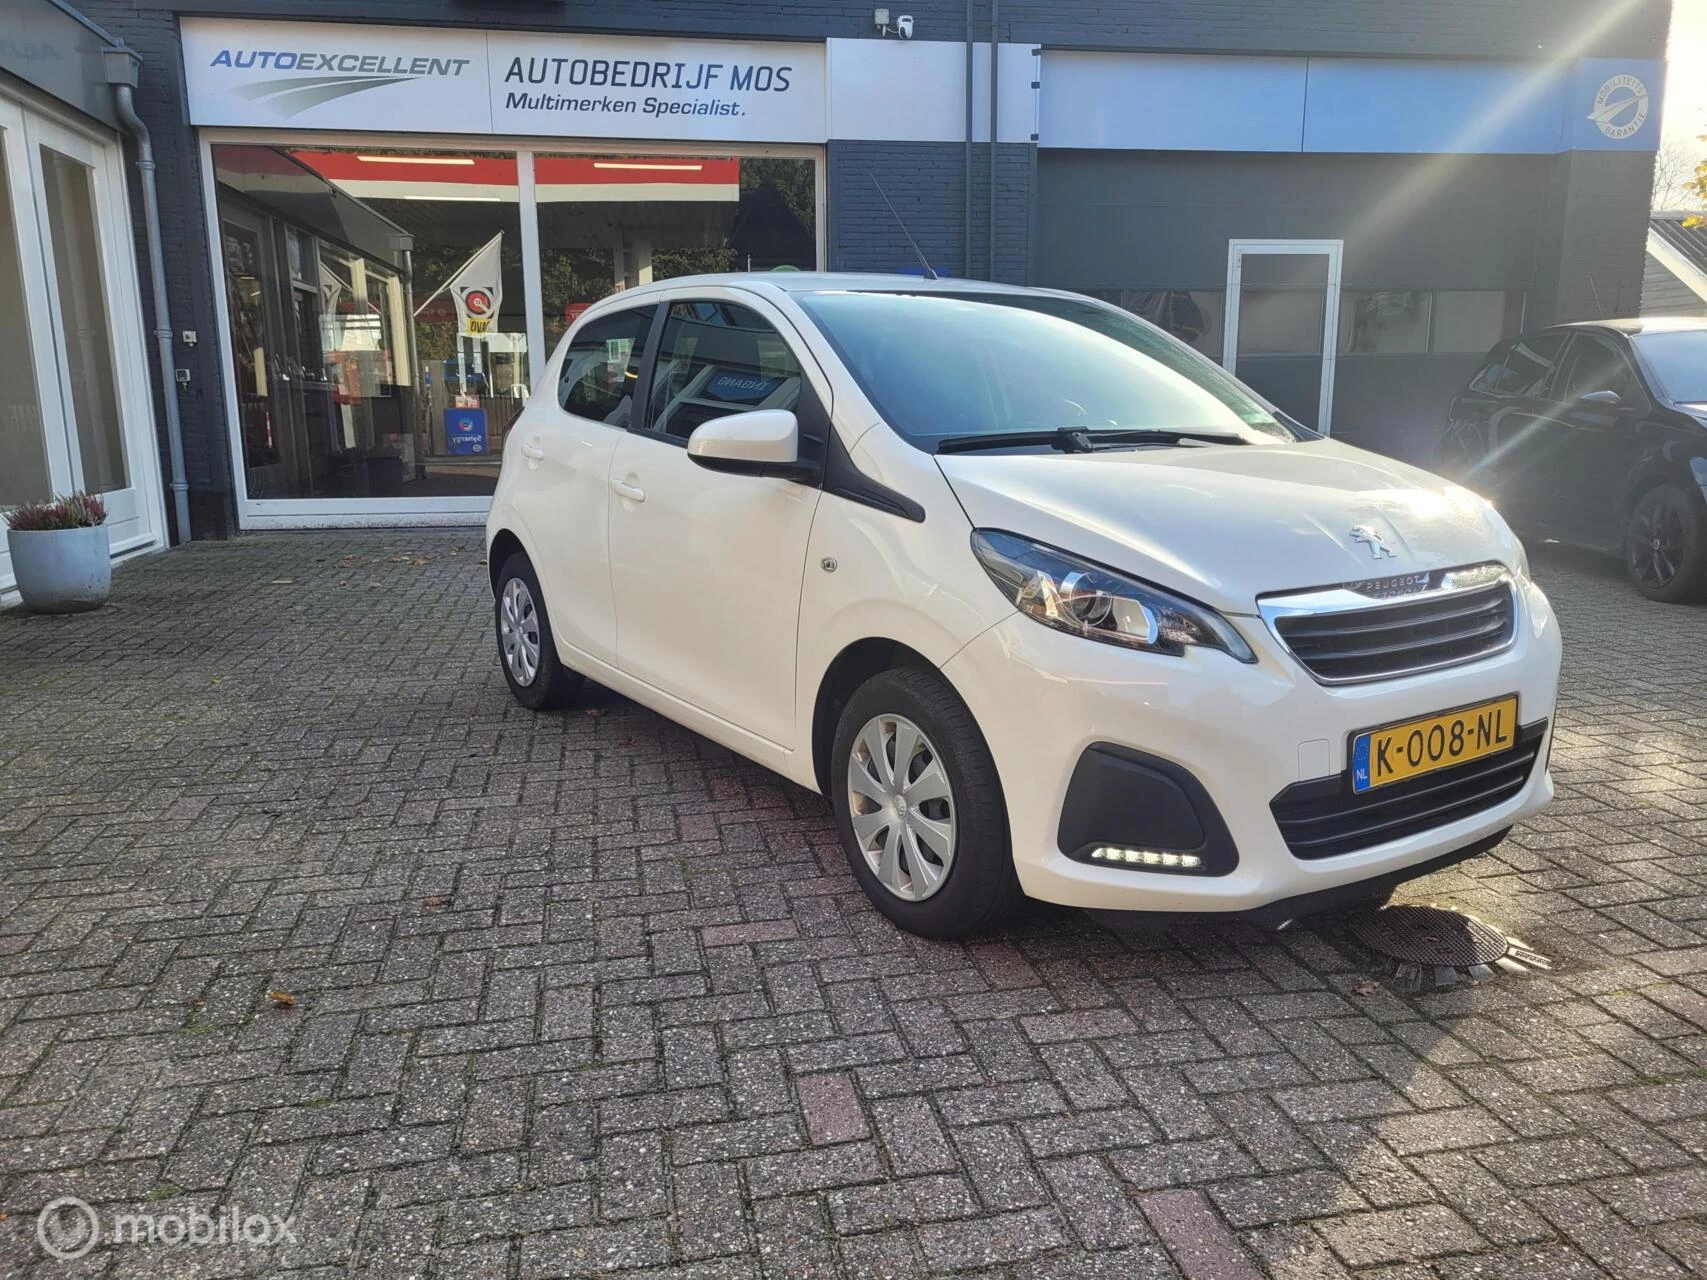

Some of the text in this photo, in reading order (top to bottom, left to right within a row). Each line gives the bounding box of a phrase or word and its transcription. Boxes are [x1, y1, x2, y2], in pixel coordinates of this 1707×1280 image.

[210, 49, 470, 76] AUTOEXCELLENT
[504, 56, 793, 92] AUTOBEDRIJF MOS
[505, 92, 746, 118] Multimerken Specialist.
[1366, 575, 1420, 591] PEUGEOT
[1376, 708, 1508, 777] K-008-NL
[1356, 769, 1368, 781] NL
